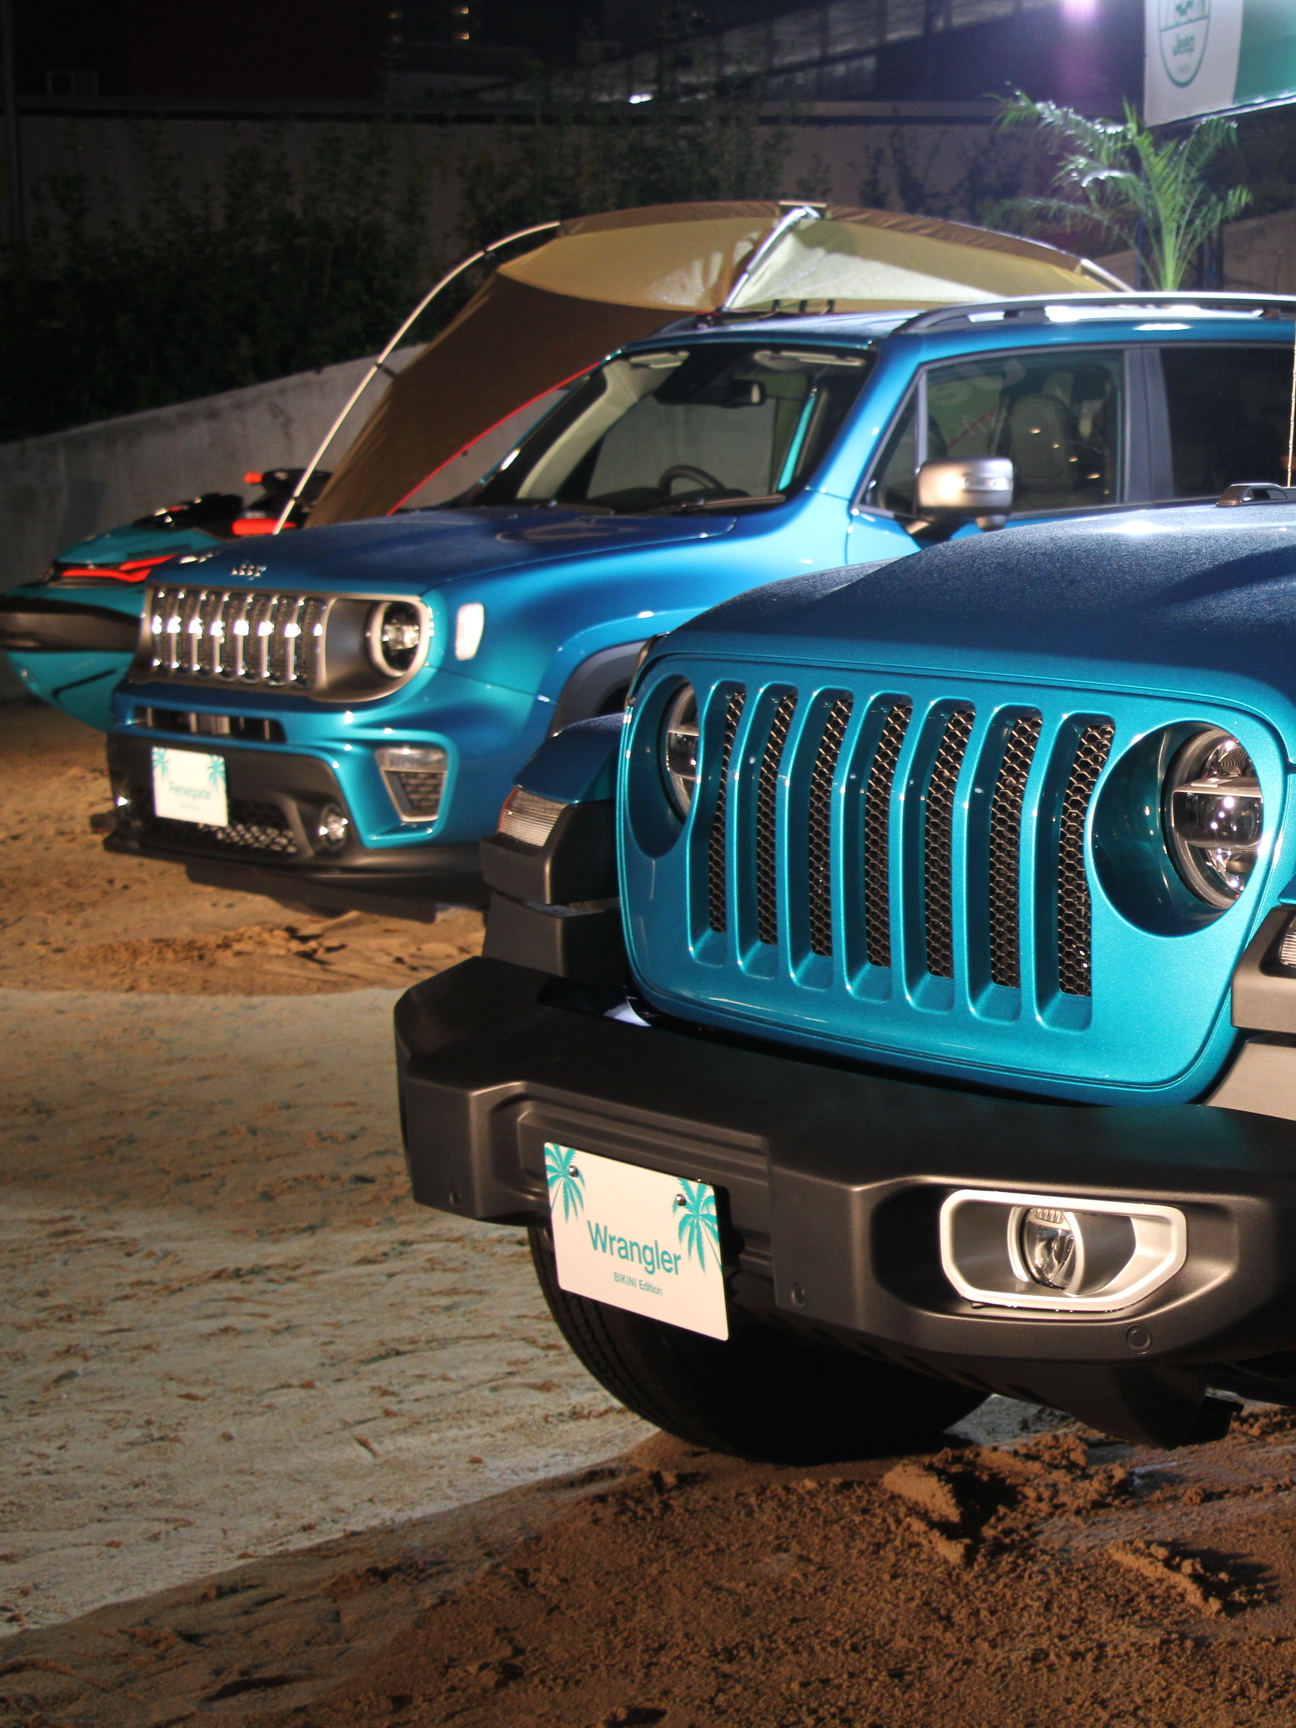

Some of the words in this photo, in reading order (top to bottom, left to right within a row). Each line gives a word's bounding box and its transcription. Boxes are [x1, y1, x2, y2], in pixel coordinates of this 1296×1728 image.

[587, 1219, 682, 1276] Wrangler
[613, 1271, 638, 1288] BIKINI
[638, 1279, 664, 1296] Edition
